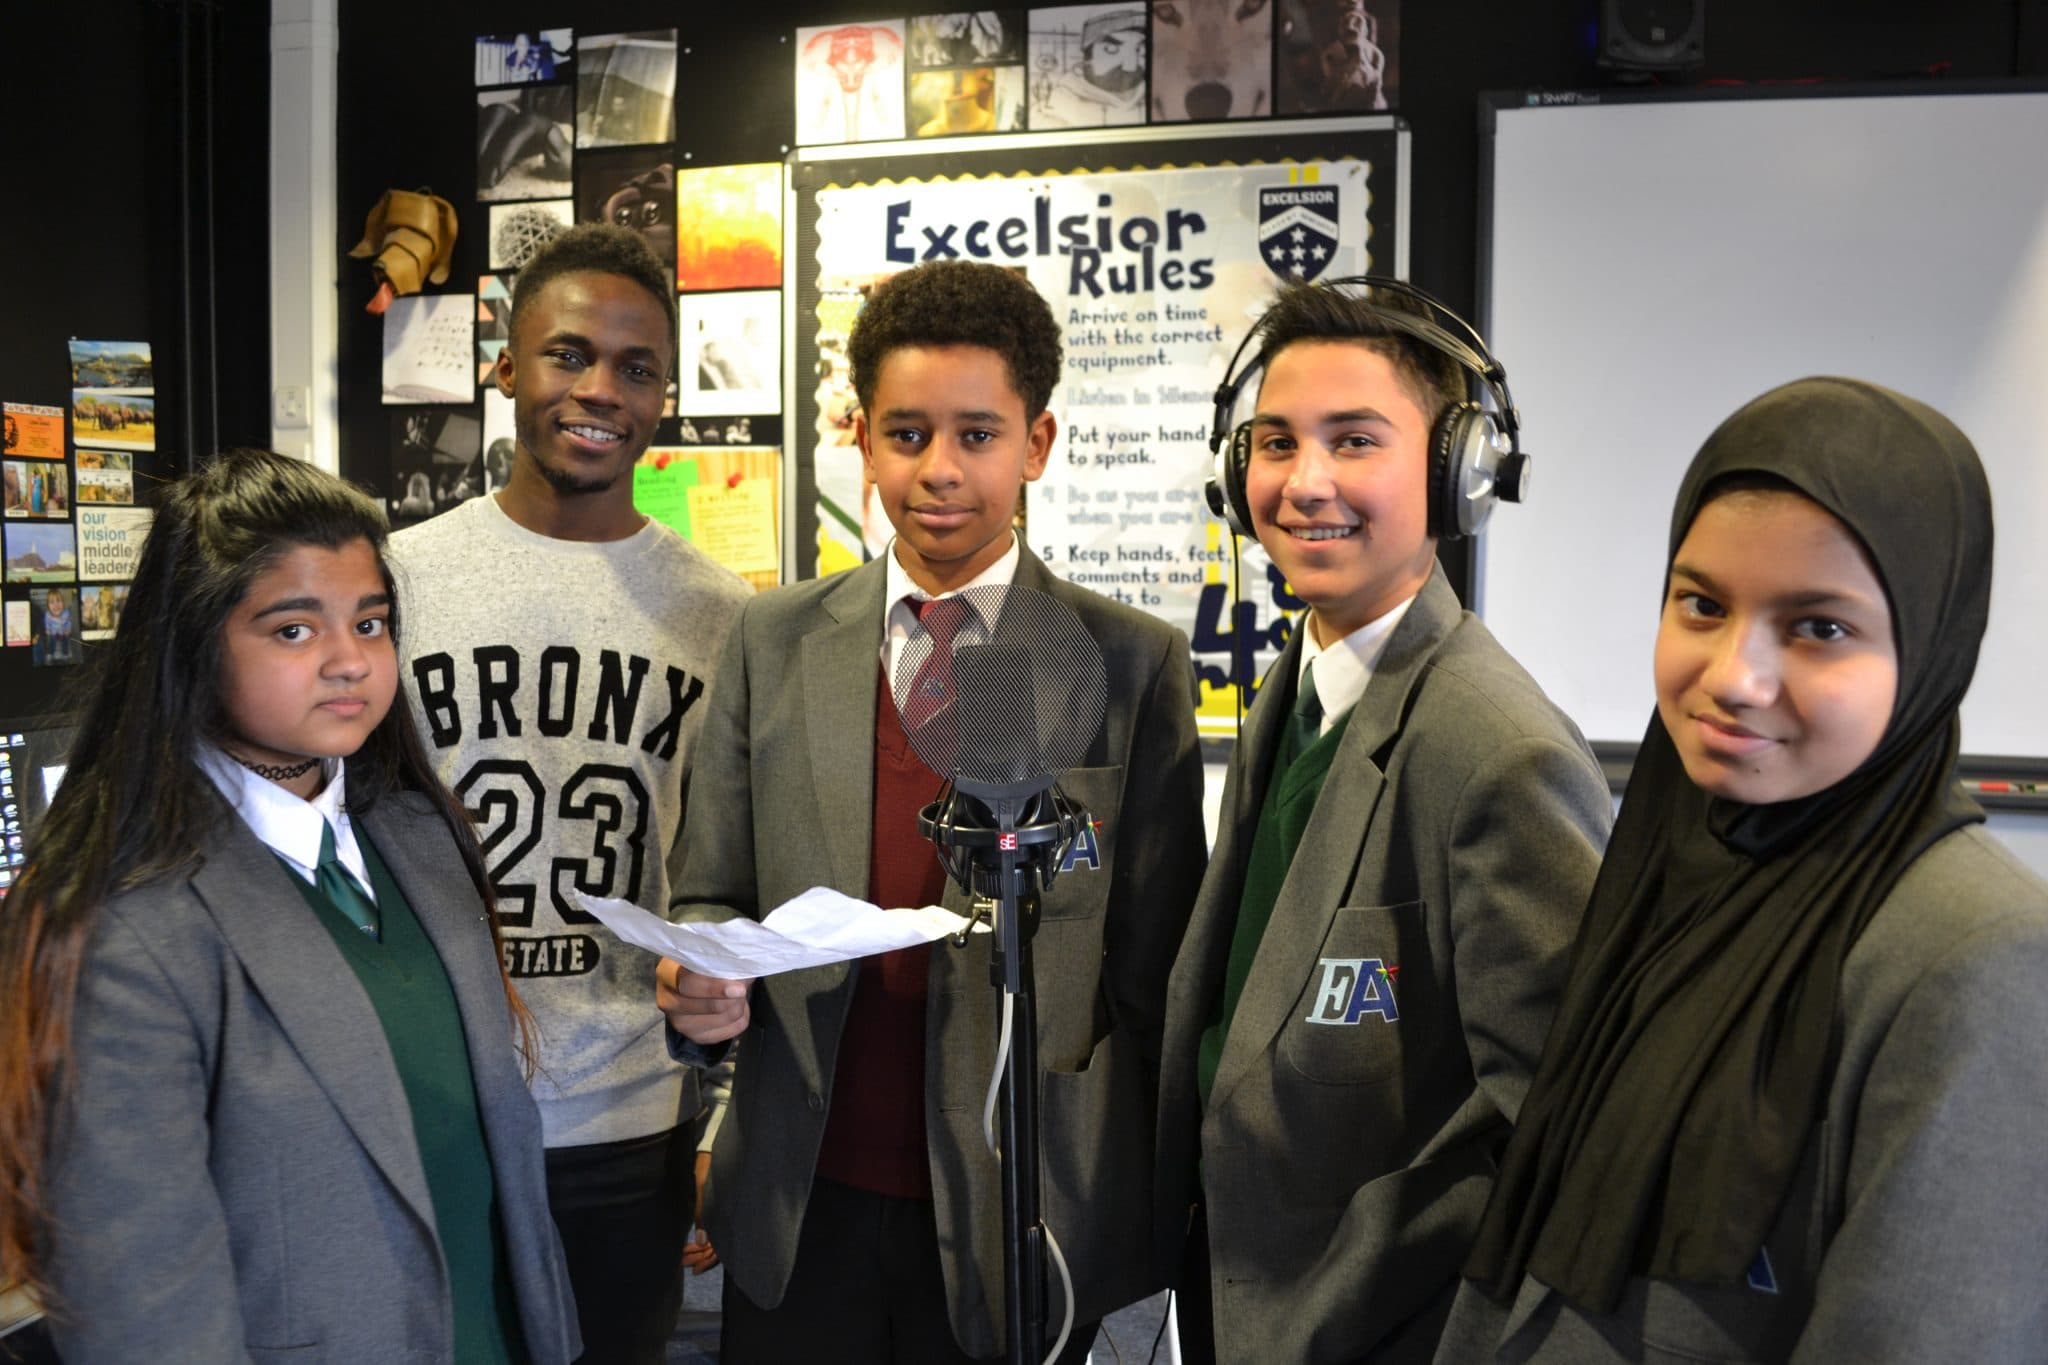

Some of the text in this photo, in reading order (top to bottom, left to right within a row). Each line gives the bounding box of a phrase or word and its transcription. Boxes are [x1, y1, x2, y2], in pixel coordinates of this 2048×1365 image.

[1262, 191, 1335, 206] EXCELSIOR
[886, 194, 1206, 264] Excelsior
[1068, 244, 1215, 299] Rules
[1068, 304, 1208, 324] Arrive on time
[1068, 325, 1223, 347] with the correct
[1068, 349, 1173, 373] equipment.
[1068, 425, 1206, 449] Put your hand
[1068, 449, 1156, 470] to speak.
[82, 512, 106, 525] our
[83, 527, 127, 541] vision
[83, 543, 132, 558] middle
[1043, 544, 1232, 566] 5 Keep hands, feet,
[84, 560, 137, 575] leaders
[1068, 567, 1204, 584] comments and
[1141, 588, 1161, 606] to
[411, 645, 705, 762] BRONX
[454, 759, 650, 928] 23
[502, 938, 585, 974] STATE
[1305, 957, 1400, 1025] EA
